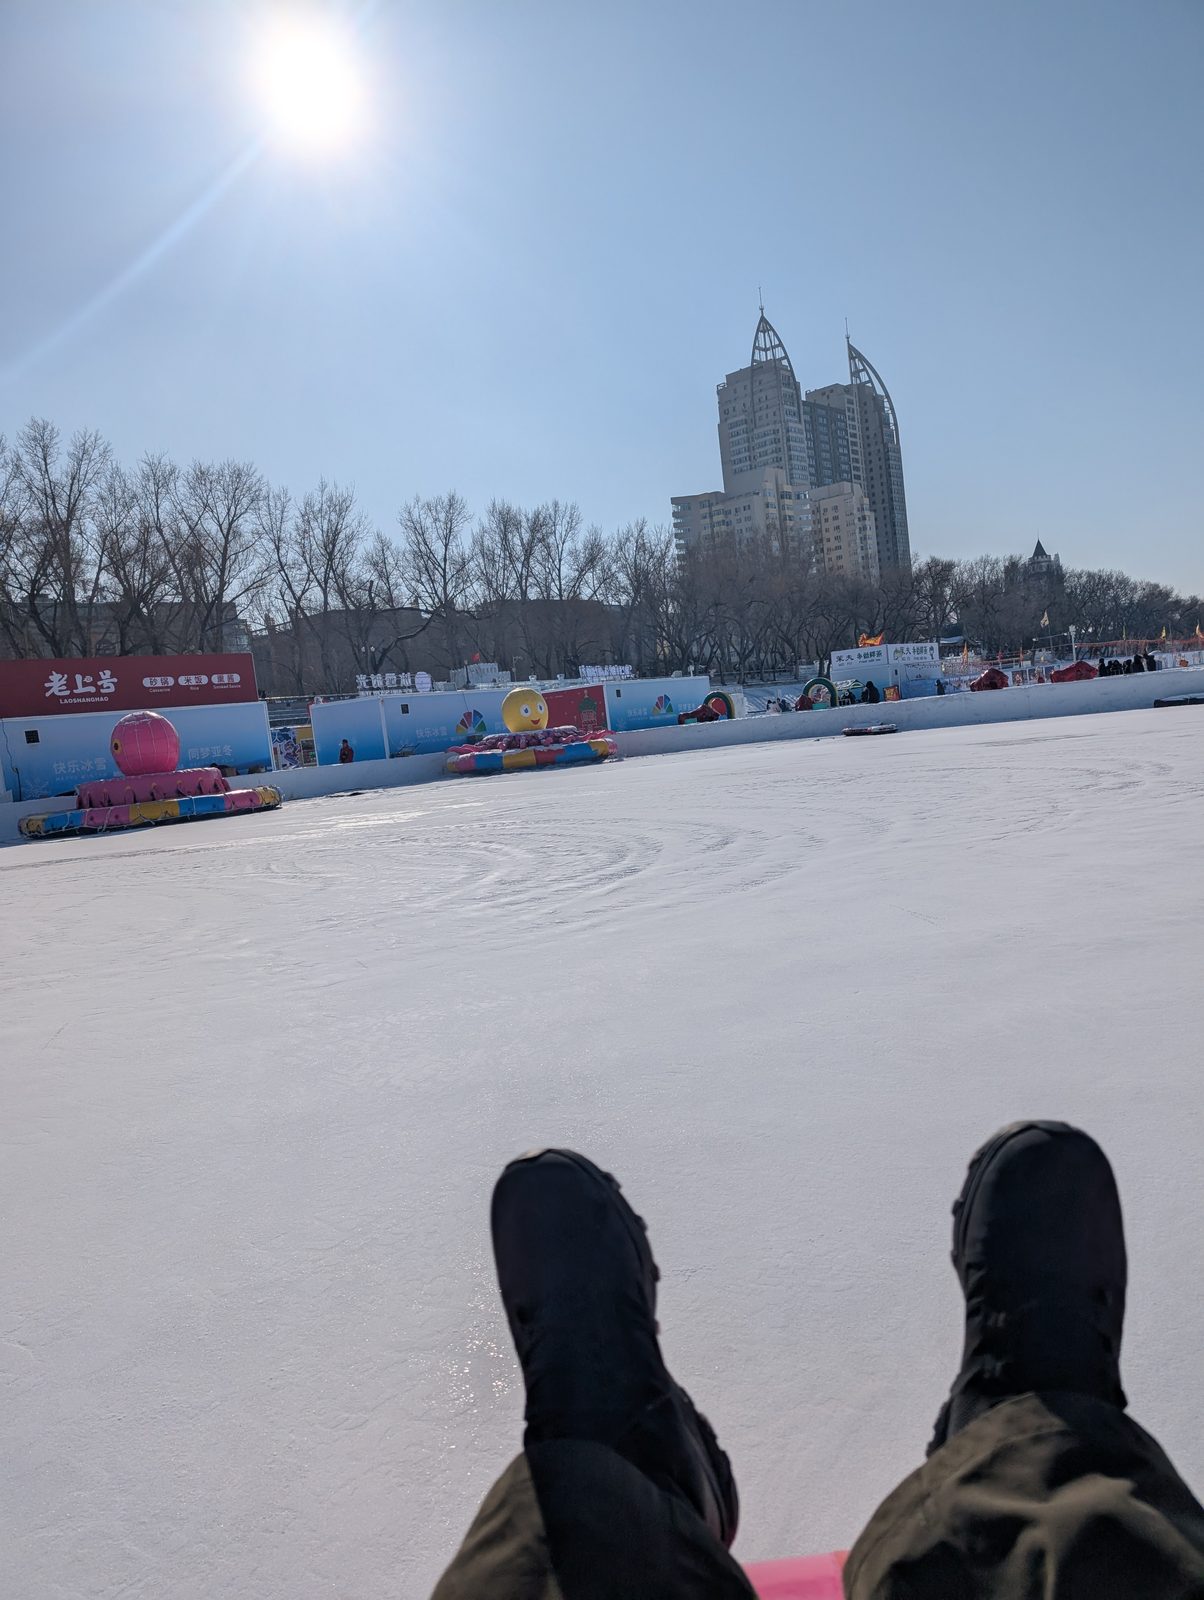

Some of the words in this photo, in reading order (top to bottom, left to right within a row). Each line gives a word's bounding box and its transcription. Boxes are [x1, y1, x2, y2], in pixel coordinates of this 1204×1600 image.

[44, 670, 118, 697] 老上号
[149, 677, 169, 685] 砂锅
[184, 676, 202, 684] 米饭
[188, 745, 233, 760] 同梦亚冬
[54, 757, 106, 774] 快乐冰雪
